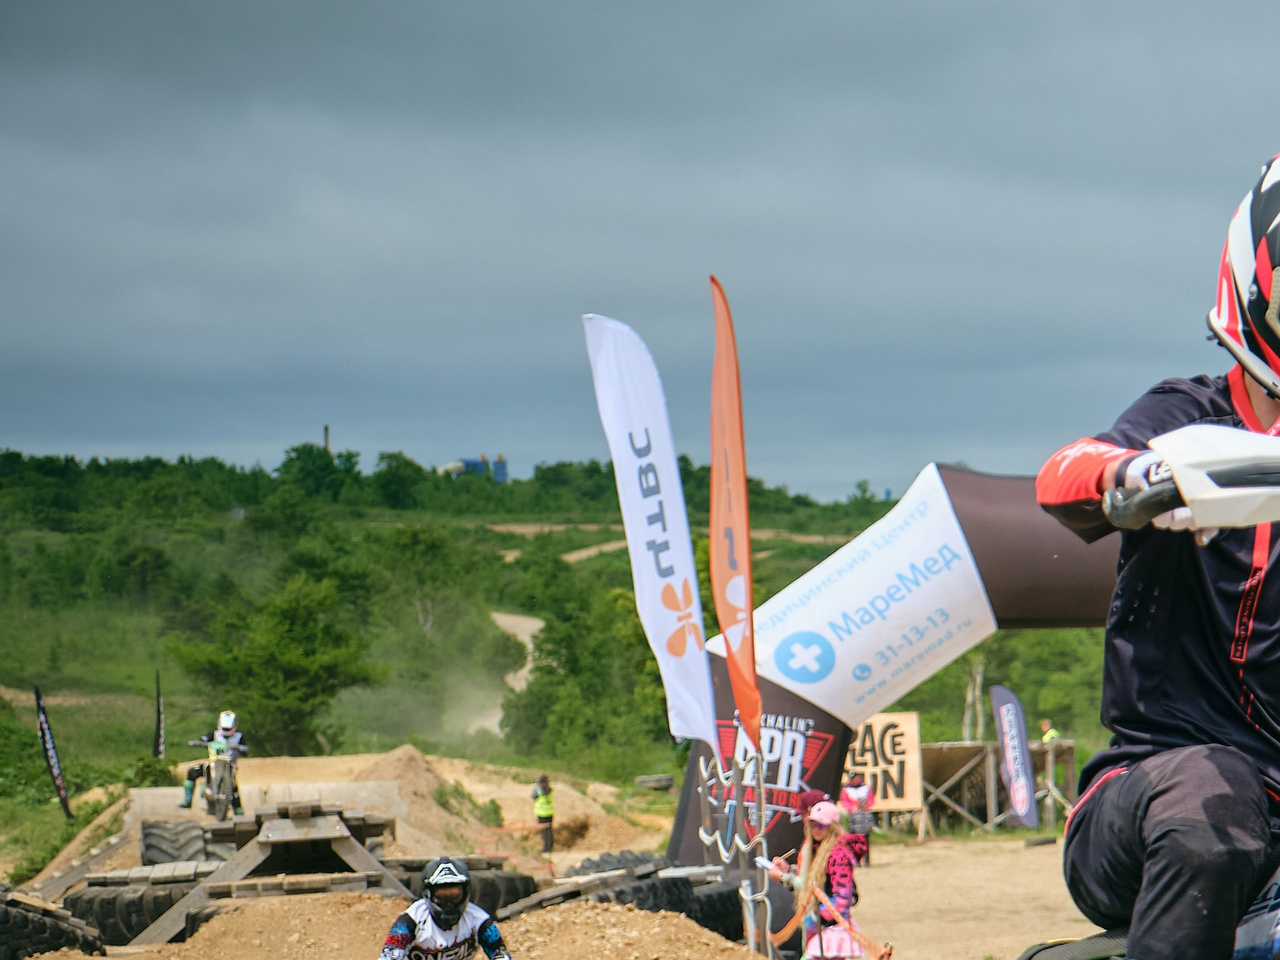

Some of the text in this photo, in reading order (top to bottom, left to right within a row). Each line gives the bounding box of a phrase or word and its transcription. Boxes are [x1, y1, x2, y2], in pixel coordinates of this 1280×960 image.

[755, 547, 871, 637] едицинский
[827, 543, 963, 643] МареМед
[874, 606, 950, 667] 31-13-13
